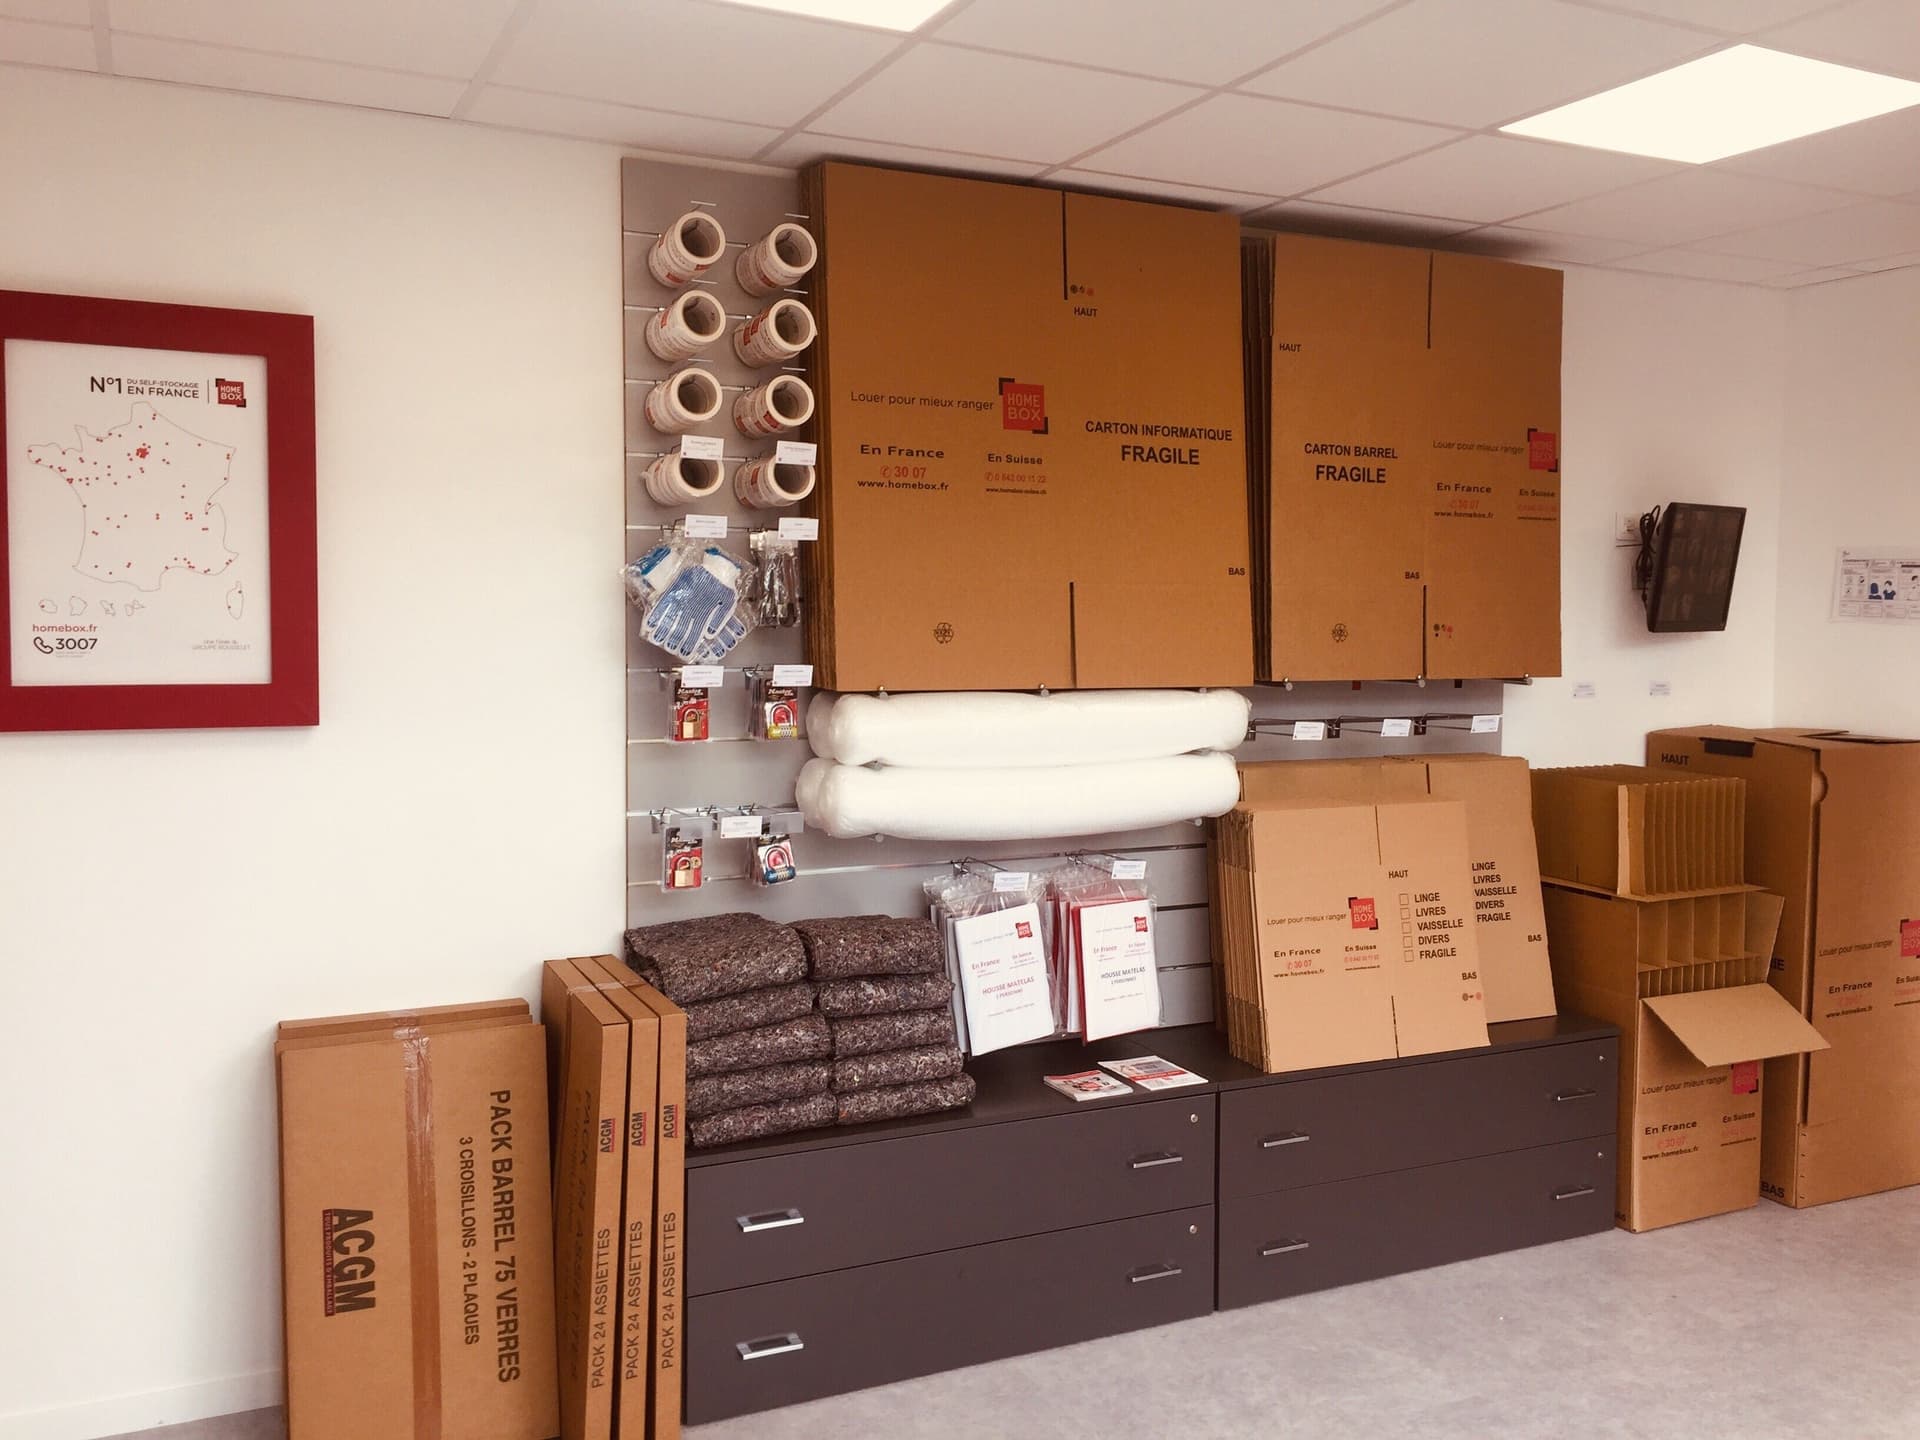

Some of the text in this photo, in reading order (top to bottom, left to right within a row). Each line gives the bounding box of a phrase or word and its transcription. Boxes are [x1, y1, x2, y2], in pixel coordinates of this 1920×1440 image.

[1074, 307, 1098, 317] HAUT
[1279, 343, 1301, 352] HAUT
[139, 379, 199, 388] SELF-STOCKAGE
[220, 385, 241, 393] HOME
[127, 386, 199, 398] EN FRANCE
[220, 392, 243, 401] BOX
[850, 391, 994, 411] Louer pour mieux ranger
[1007, 393, 1041, 408] HOME
[1008, 407, 1041, 421] BOX
[1085, 421, 1232, 441] CARTON INFORMATIQUE
[860, 444, 945, 459] En France
[1121, 445, 1200, 465] FRAGILE
[1304, 443, 1398, 459] CARTON BARREL
[987, 453, 1043, 465] En Suisse
[894, 466, 926, 479] 30 07
[1315, 464, 1386, 484] FRAGILE
[857, 480, 950, 492] www.homebox.fr
[1437, 482, 1492, 494] En France
[1228, 567, 1245, 576] BAS
[1405, 571, 1420, 579] BAS
[32, 624, 97, 633] homebox.fr
[55, 638, 98, 650] 3007
[1661, 753, 1690, 766] HAUT
[1472, 861, 1496, 871] LINGE
[1388, 870, 1408, 879] HAUT
[1473, 874, 1501, 884] LIVRES
[1474, 886, 1517, 897] VAISSELLE
[1414, 892, 1440, 904] LINGE
[1353, 904, 1373, 914] HOME
[1475, 899, 1504, 910] DIVERS
[1415, 905, 1446, 917] LIVRES
[1476, 911, 1511, 923] FRAGILE
[1267, 913, 1347, 926] Louer pour mieux ranger
[1353, 913, 1374, 922] BOX
[1417, 918, 1463, 931] VAISSELLE
[1418, 933, 1450, 945] DIVERS
[1528, 934, 1542, 943] BAS
[1274, 948, 1321, 958] En France
[1419, 947, 1457, 960] FRAGILE
[972, 958, 1000, 970] En France
[1101, 966, 1146, 980] HOUSSE MATELAS
[1462, 971, 1477, 980] BAS
[982, 976, 1035, 995] HOUSSE MATELAS
[1829, 981, 1873, 994] En France
[1642, 1085, 1663, 1095] Louer
[1665, 1082, 1682, 1092] pour
[664, 1104, 675, 1139] ACGM
[631, 1112, 643, 1147] ACGM
[1645, 1120, 1697, 1136] En France
[459, 1136, 474, 1145] 3
[601, 1118, 613, 1153] ACGM
[1760, 1181, 1785, 1198] BAS
[459, 1149, 477, 1249] CROISILLONS
[490, 1089, 520, 1384] PACK BARREL 75 VERRES
[333, 1208, 376, 1314] ACGM
[463, 1260, 477, 1269] 2
[661, 1212, 676, 1369] PACK 24 ASSIETTES
[625, 1221, 643, 1380] PACK 24 ASSIETTES
[463, 1273, 480, 1345] PLAQUES
[591, 1229, 610, 1389] PACK 24 ASSIETTES
